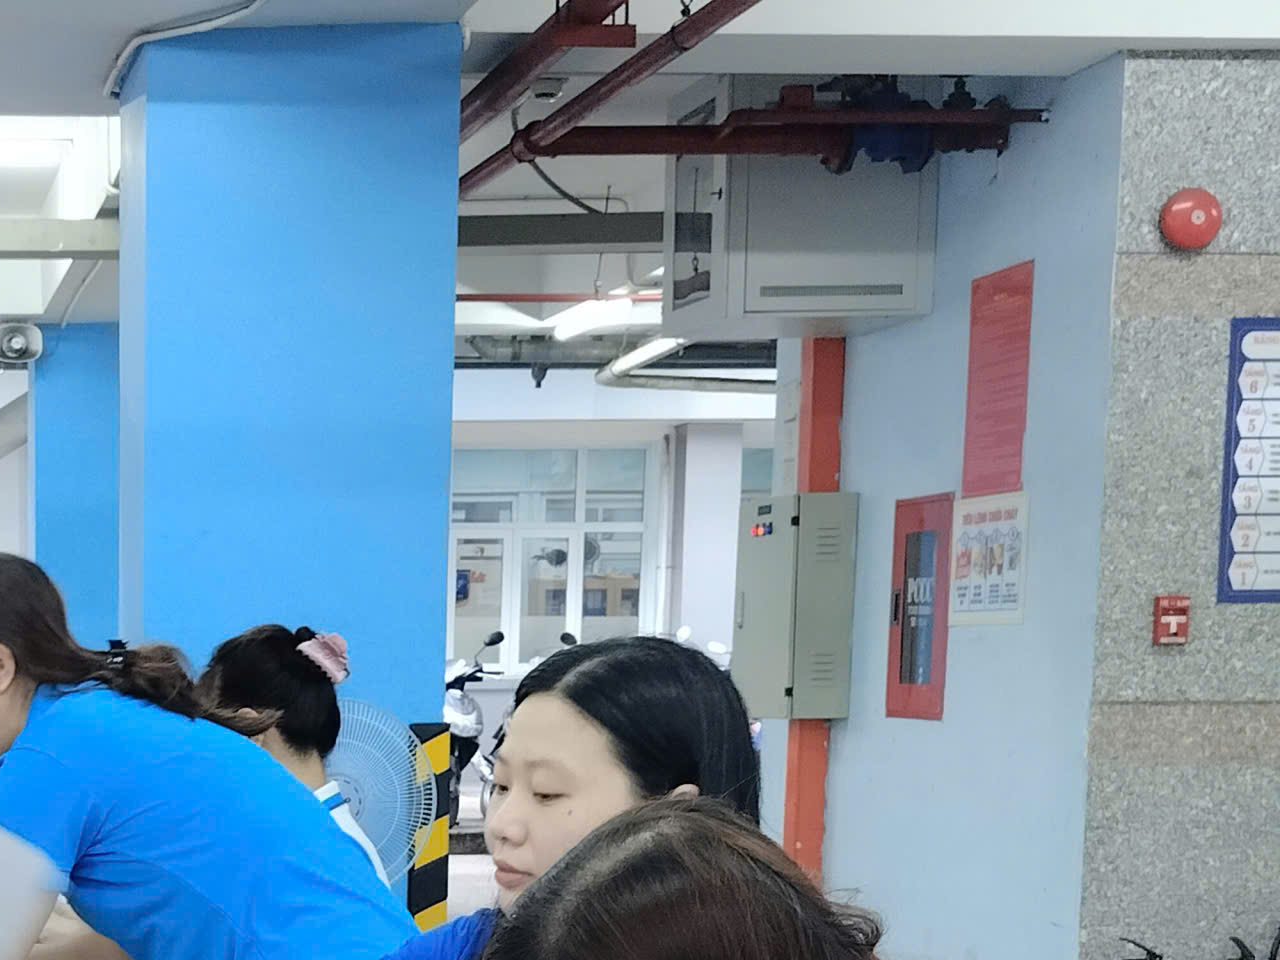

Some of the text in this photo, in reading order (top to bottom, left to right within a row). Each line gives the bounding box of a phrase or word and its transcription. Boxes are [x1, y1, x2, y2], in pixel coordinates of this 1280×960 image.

[1249, 380, 1258, 393] 6
[1247, 418, 1256, 432] 5
[1245, 457, 1253, 472] 4
[1243, 495, 1252, 510] 3
[1241, 534, 1250, 547] 2
[1240, 572, 1247, 586] 1
